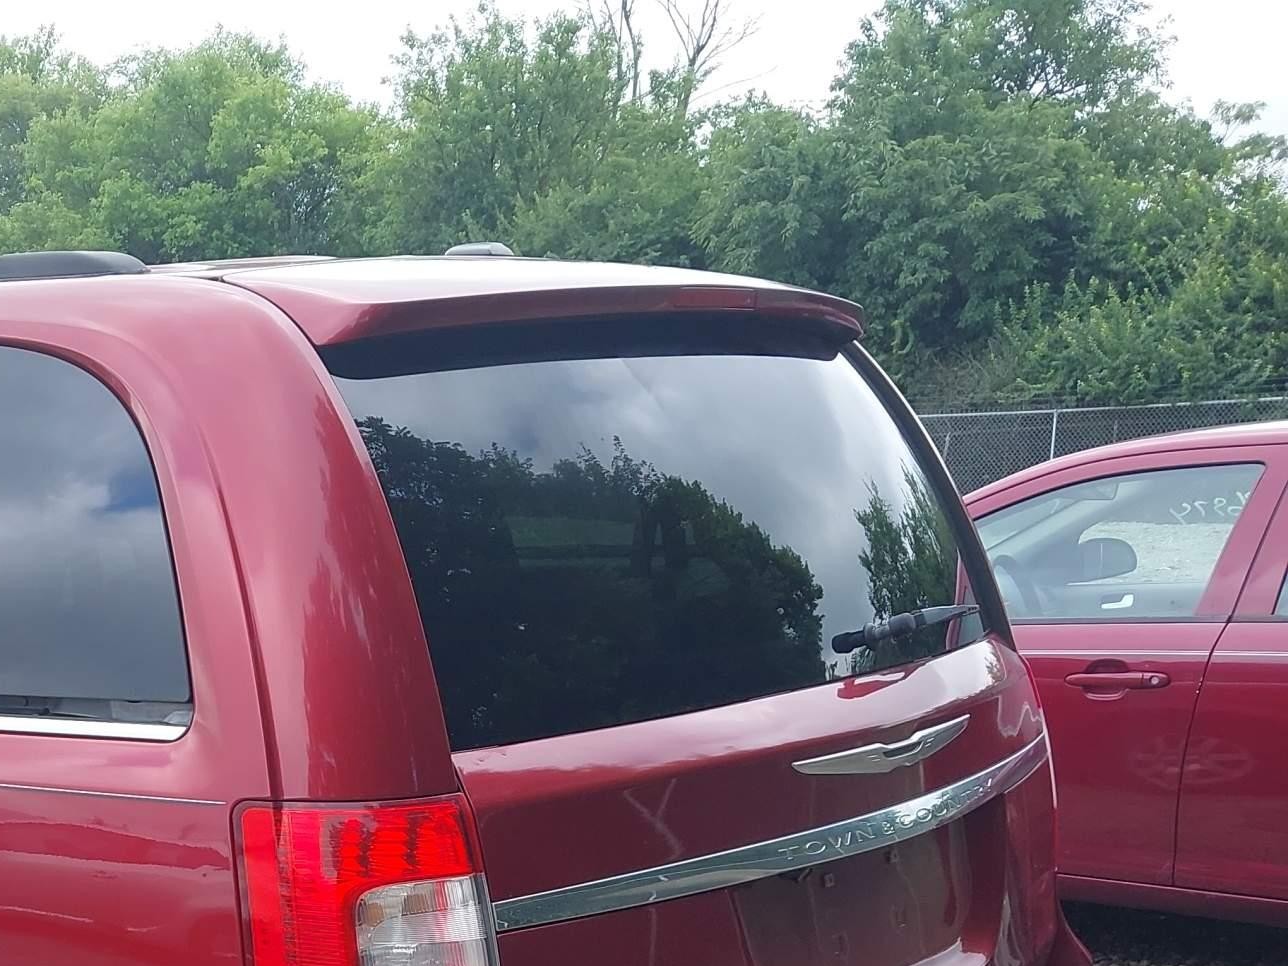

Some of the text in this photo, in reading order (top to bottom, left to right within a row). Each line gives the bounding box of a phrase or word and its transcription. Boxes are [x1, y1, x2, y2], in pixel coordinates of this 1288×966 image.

[778, 778, 993, 860] TOWN & COUNTRY
